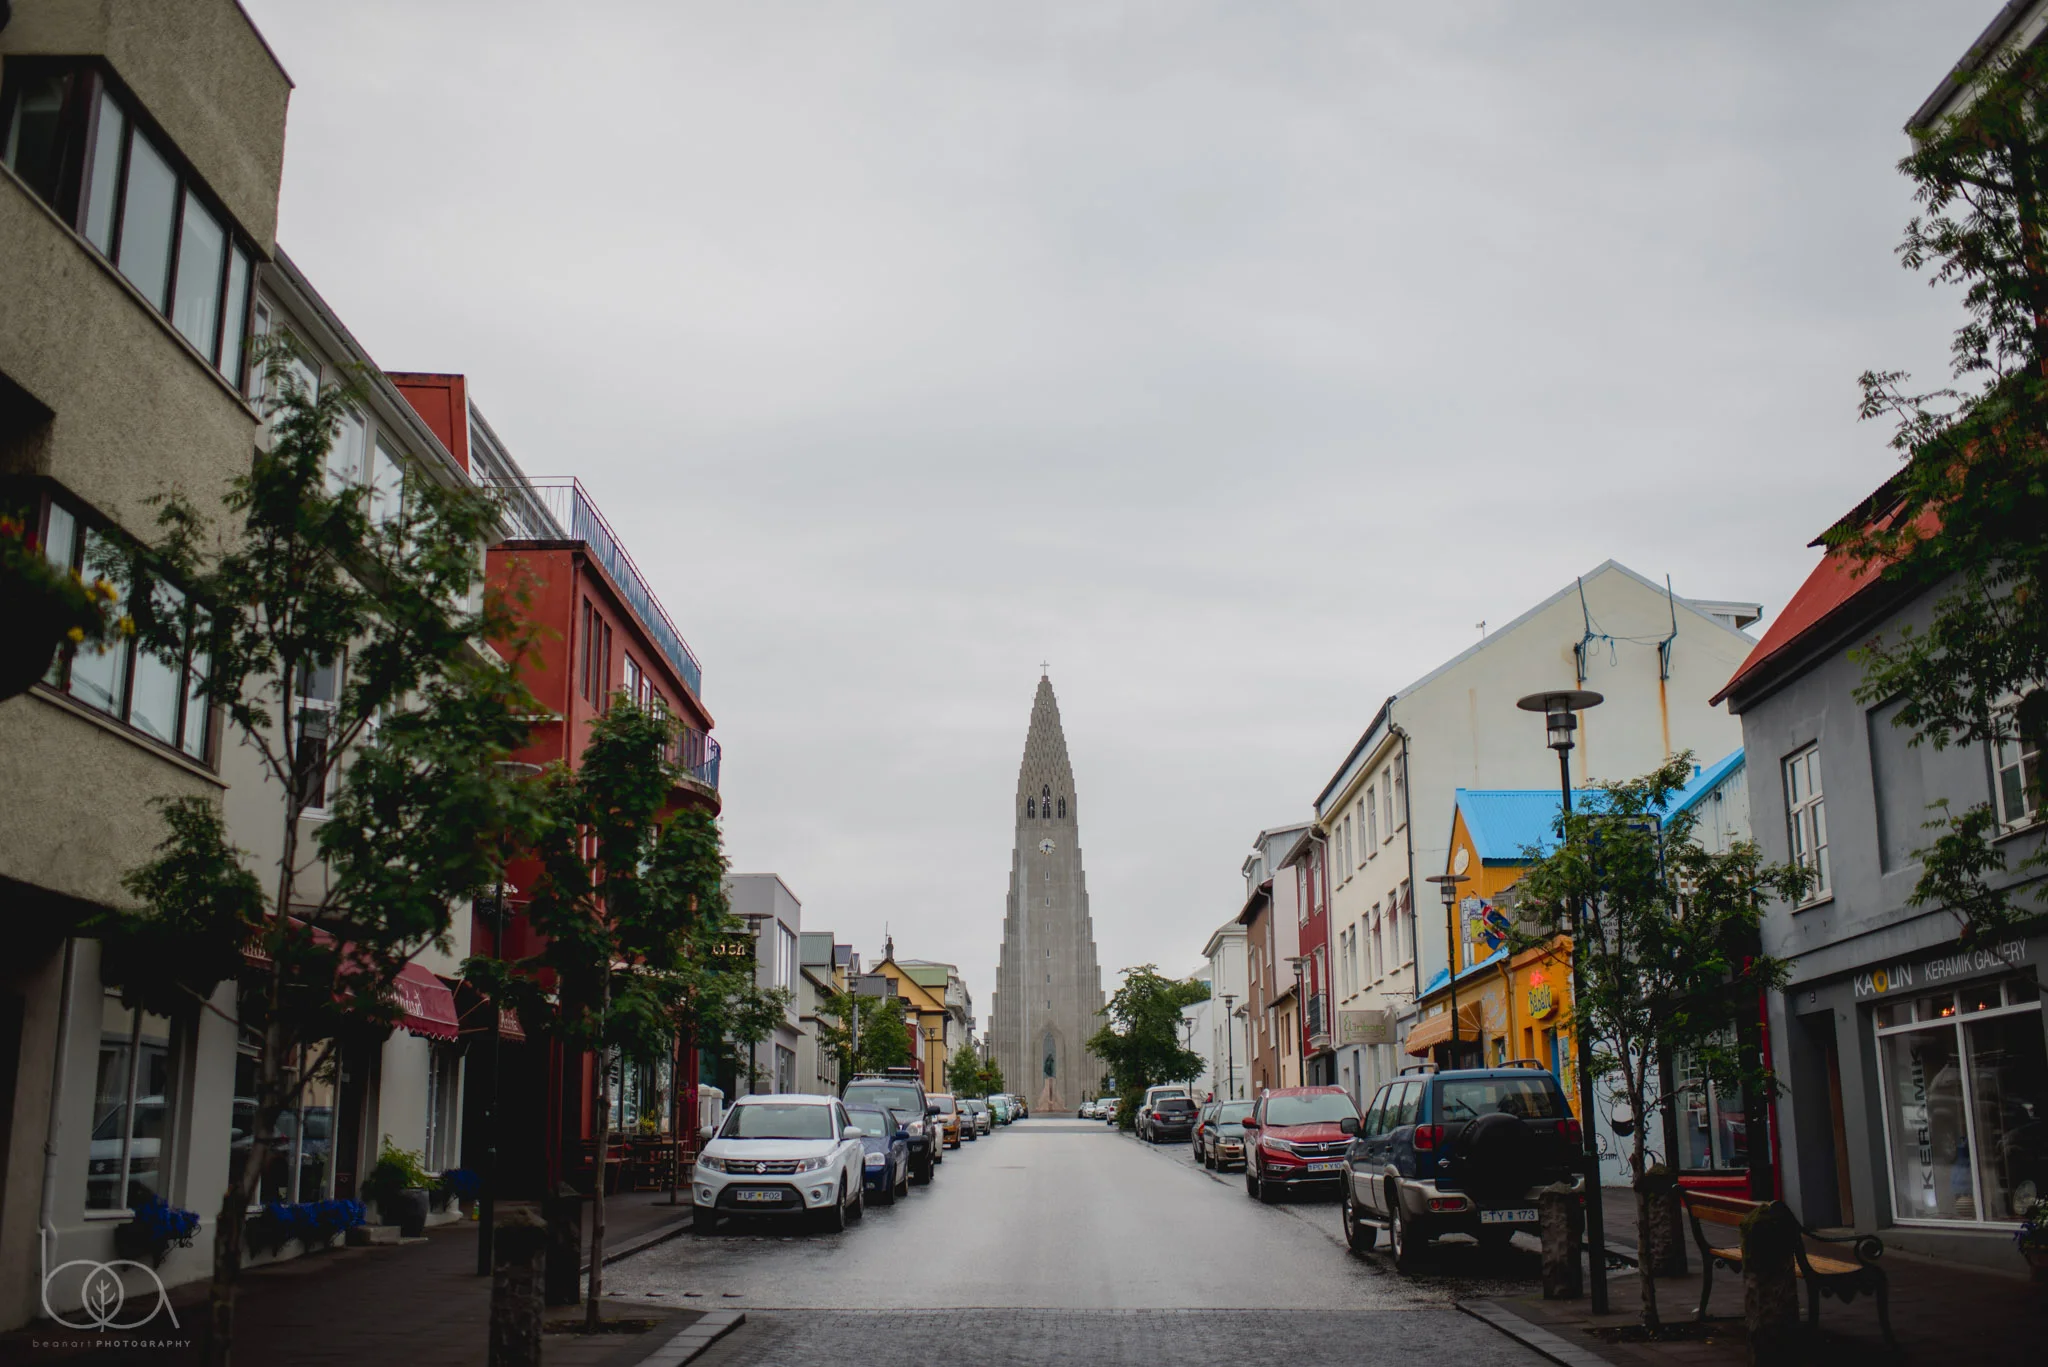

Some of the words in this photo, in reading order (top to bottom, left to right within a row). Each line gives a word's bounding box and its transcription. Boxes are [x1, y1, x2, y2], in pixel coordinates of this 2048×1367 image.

[1853, 963, 1913, 997] KAOLIN
[1924, 951, 1973, 981] KERAMIK
[1974, 937, 2027, 971] GALLERY
[1909, 1046, 1934, 1191] KERAMIK
[743, 1192, 756, 1200] UF
[762, 1192, 780, 1200] F02
[1489, 1211, 1504, 1221] TY
[1516, 1210, 1535, 1220] 173
